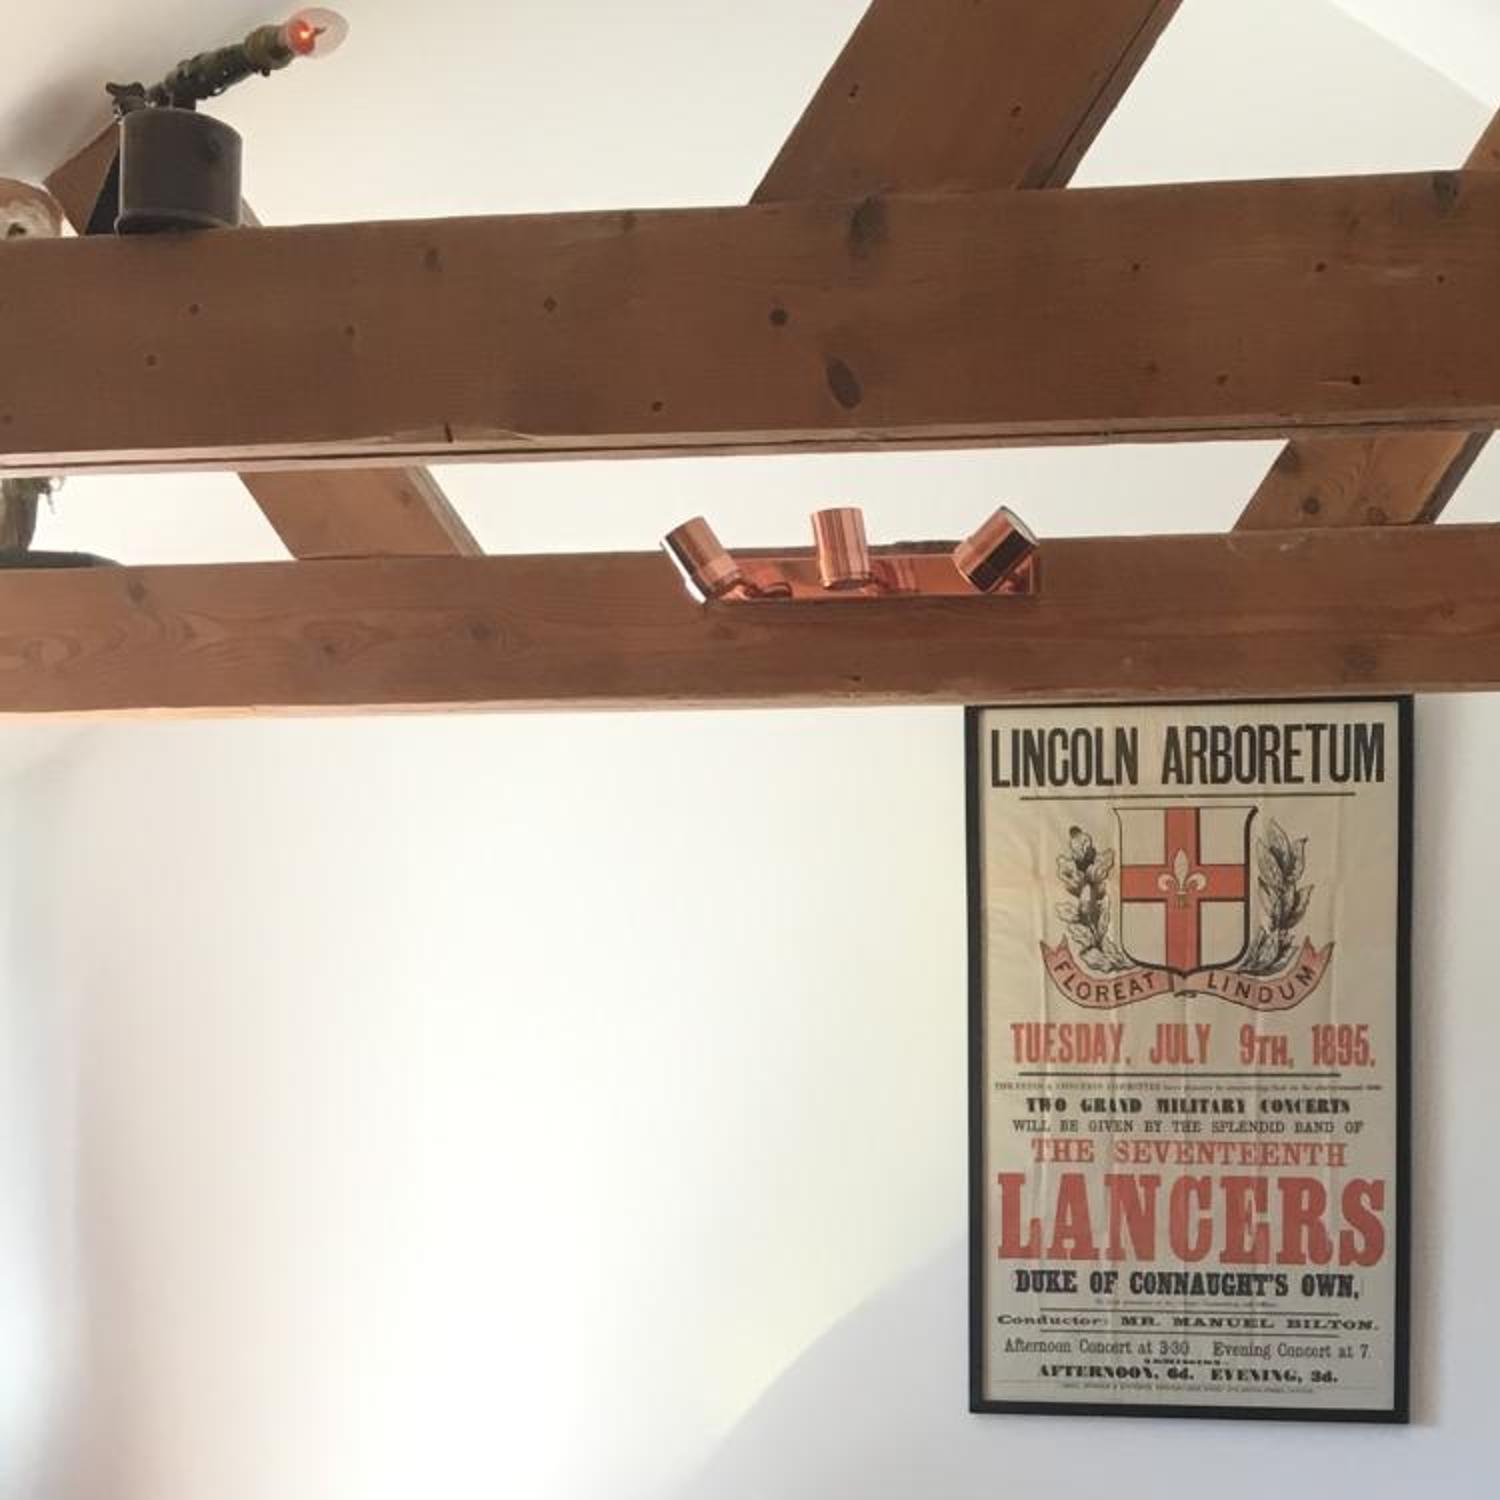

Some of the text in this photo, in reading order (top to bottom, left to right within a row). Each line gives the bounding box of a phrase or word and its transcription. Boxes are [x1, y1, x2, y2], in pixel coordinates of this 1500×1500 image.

[991, 722, 1385, 788] LINCOLN ARBORETUM
[1053, 961, 1315, 1004] FLOREAT LINDUM
[1149, 1023, 1211, 1065] JULY
[1025, 1097, 1350, 1115] TWO GRAND MILITARY CONCERTS
[1012, 1119, 1364, 1134] WILL BE GIVEN BY THE SPLENDID BAND OF
[1032, 1138, 1348, 1167] THE SEVENTEENTH
[997, 1172, 1386, 1268] LANCERS
[1014, 1269, 1078, 1293] DUKE
[1090, 1270, 1118, 1294] OF
[1129, 1271, 1289, 1297] CONNAUGHT'S
[1172, 1316, 1275, 1329] MANUEL
[1004, 1337, 1071, 1354] Afternoon
[1079, 1338, 1132, 1355] Concert
[1137, 1340, 1153, 1355] at
[1212, 1340, 1273, 1361] Evening
[1277, 1342, 1332, 1359] Concert
[1338, 1344, 1354, 1359] at
